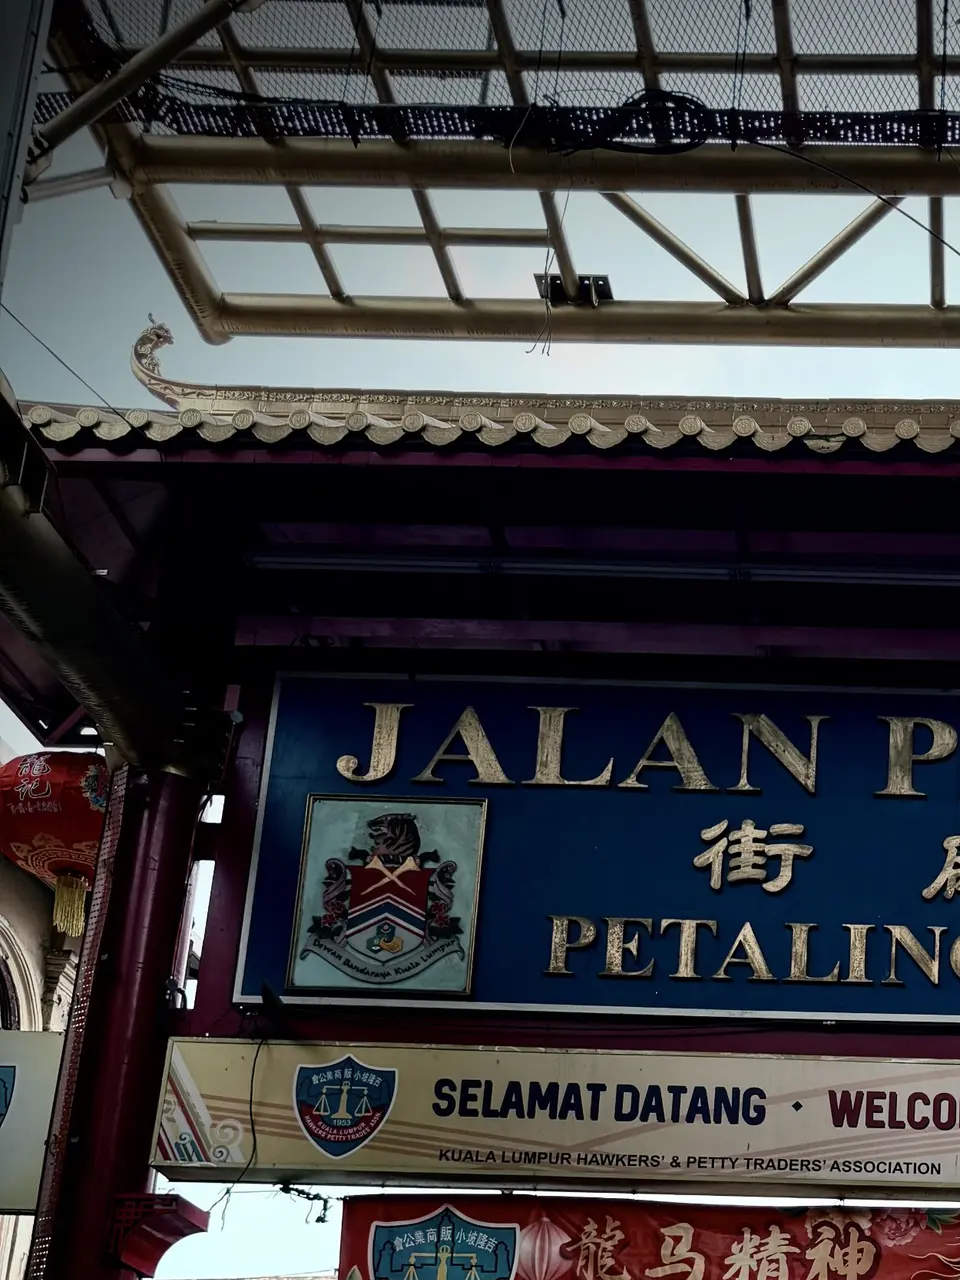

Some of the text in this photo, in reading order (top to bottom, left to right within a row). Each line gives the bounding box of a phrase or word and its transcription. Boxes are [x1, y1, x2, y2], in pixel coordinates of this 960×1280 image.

[335, 702, 830, 793] JALAN
[312, 938, 457, 981] Dewan Bandaraya Kuala Lumpur
[431, 1078, 767, 1127] SELAMAT DATANG
[317, 1121, 367, 1135] KUALA LUMPUR
[333, 1118, 352, 1127] 1953
[326, 1133, 347, 1142] PETTY
[438, 1149, 942, 1176] KUALA LUMPUR HAWKERS' & PETTY TRADERS' ASSOCIATION
